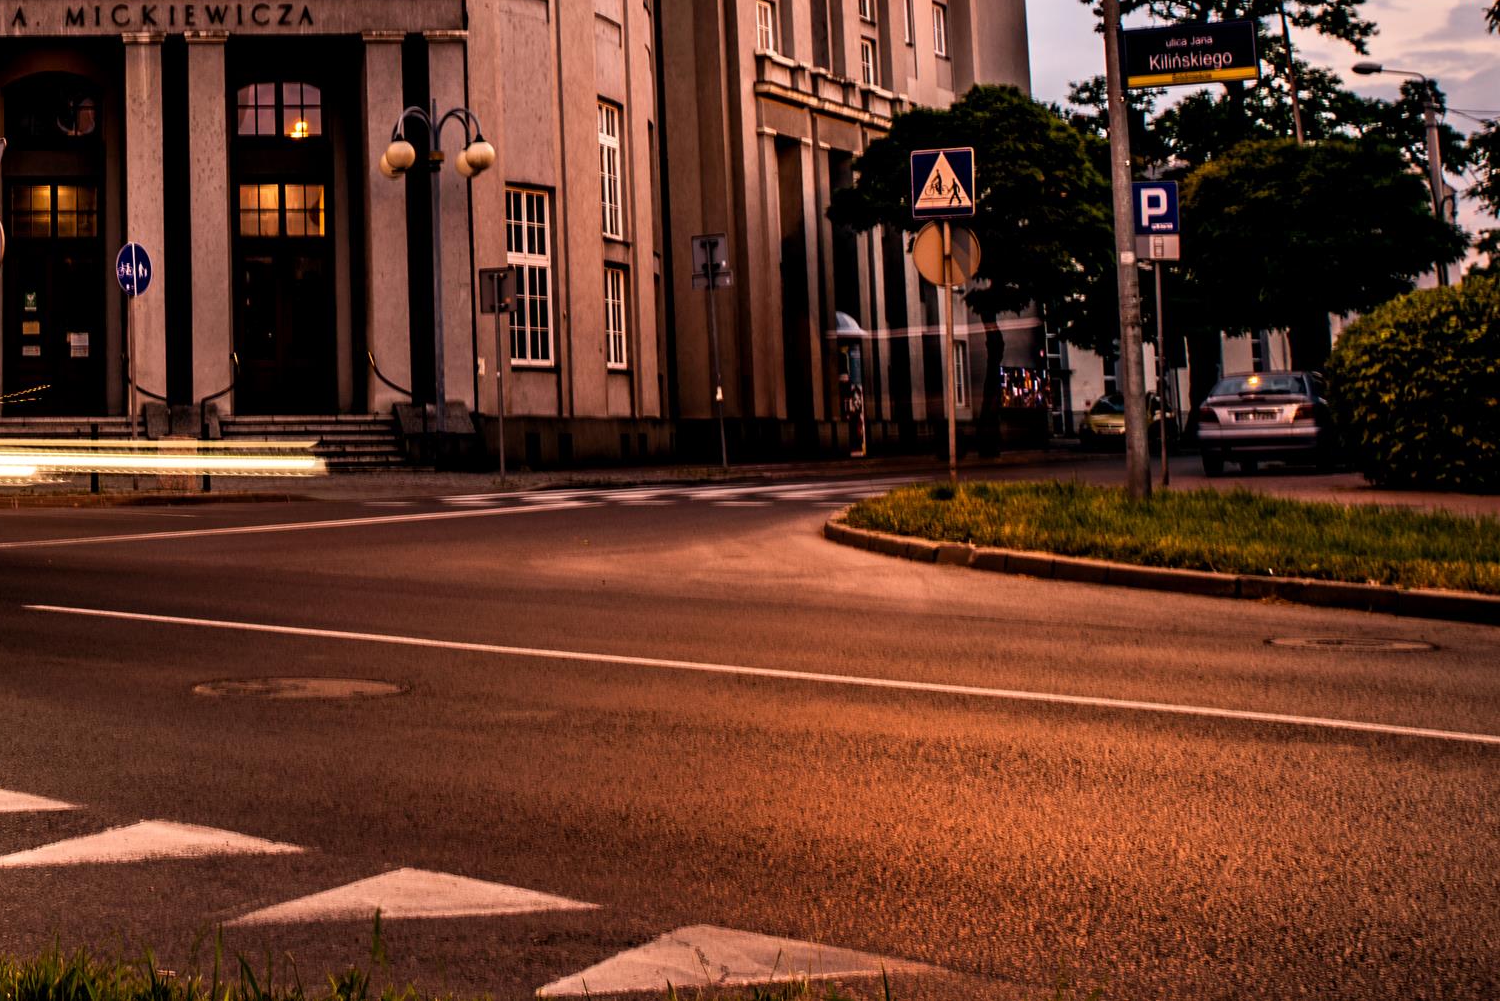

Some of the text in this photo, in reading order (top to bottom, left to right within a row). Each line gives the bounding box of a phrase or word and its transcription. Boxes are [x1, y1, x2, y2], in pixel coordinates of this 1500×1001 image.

[11, 5, 41, 27] A.
[65, 4, 315, 27] MICKIEWICZA
[1165, 35, 1213, 48] ulica Jana
[1149, 50, 1233, 71] Kilińskiego
[1140, 187, 1168, 228] P
